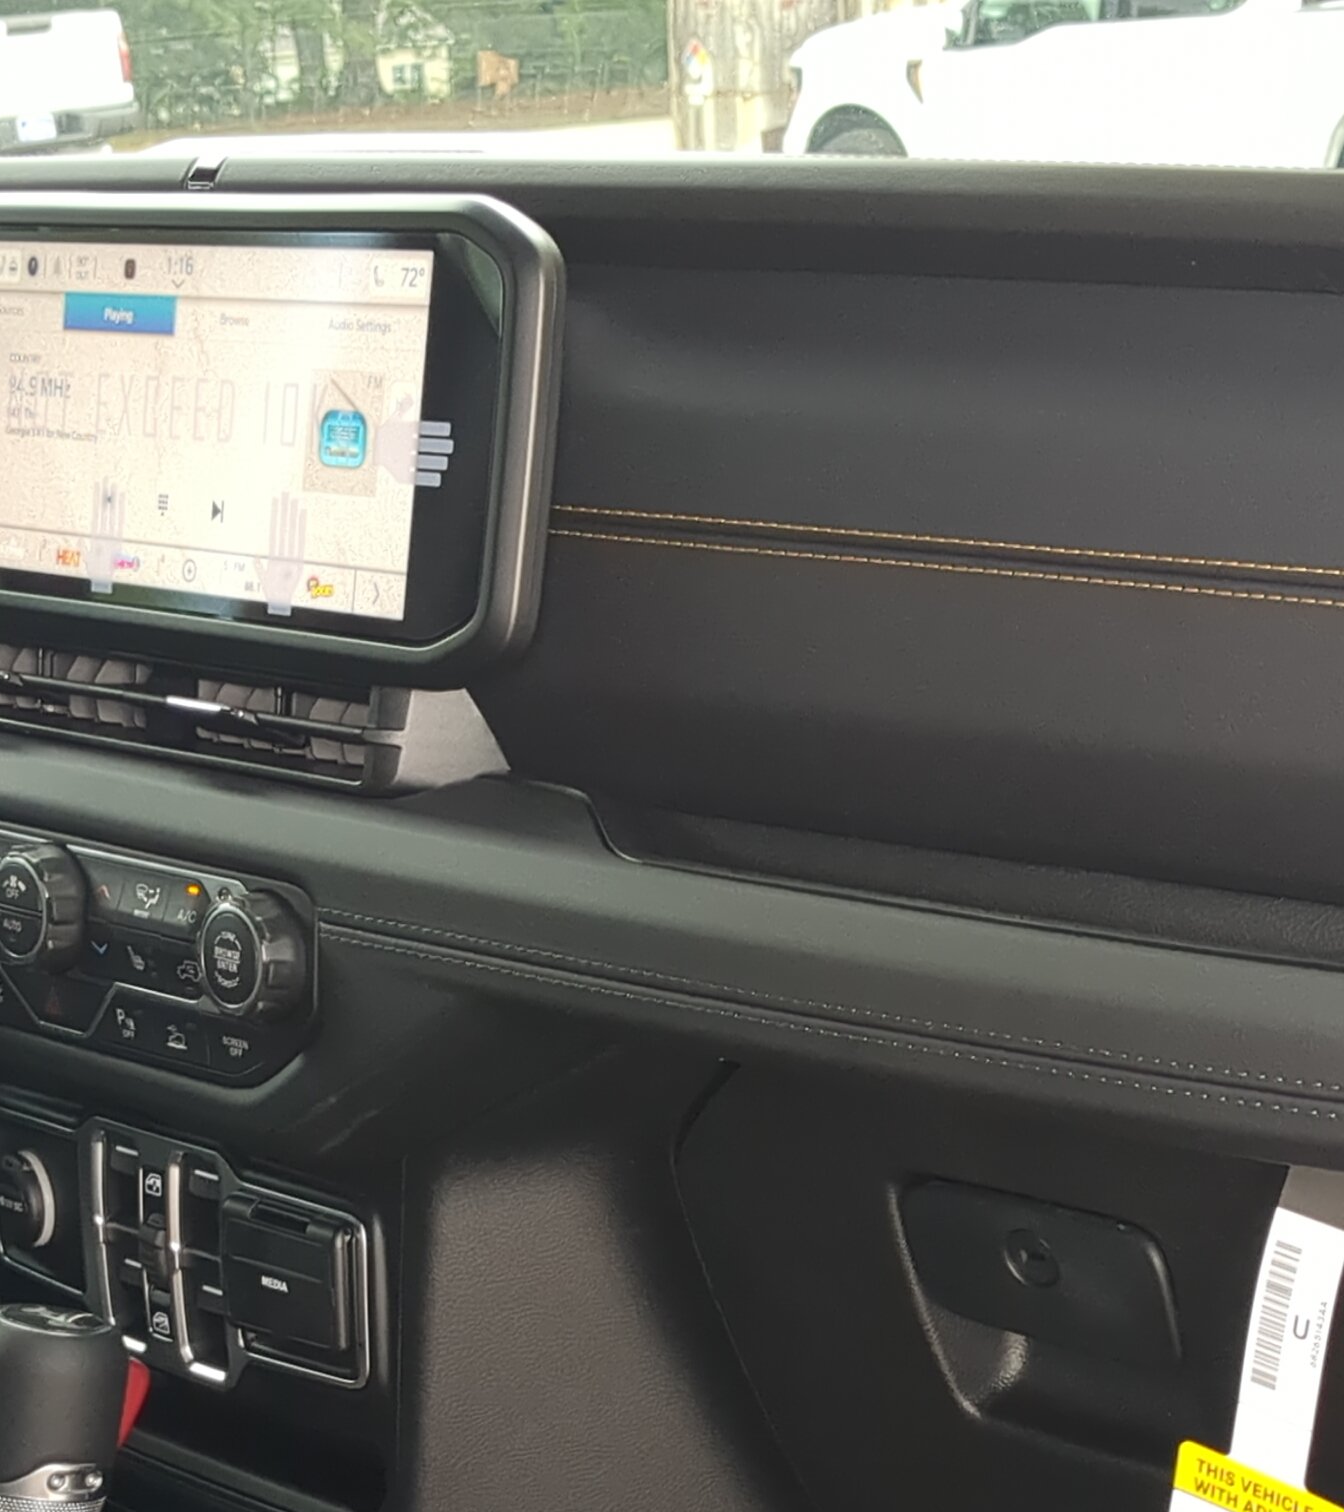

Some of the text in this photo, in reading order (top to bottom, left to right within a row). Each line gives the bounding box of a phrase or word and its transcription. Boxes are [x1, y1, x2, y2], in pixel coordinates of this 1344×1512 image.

[166, 255, 194, 276] 1:16
[400, 266, 426, 288] 72°
[104, 307, 134, 325] Playing
[328, 318, 354, 332] Audio
[176, 908, 197, 924] A/C
[261, 1274, 289, 1294] MEDIA
[1292, 1314, 1311, 1341] U
[1196, 1457, 1236, 1488] THIS
[1193, 1476, 1239, 1509] WITH
